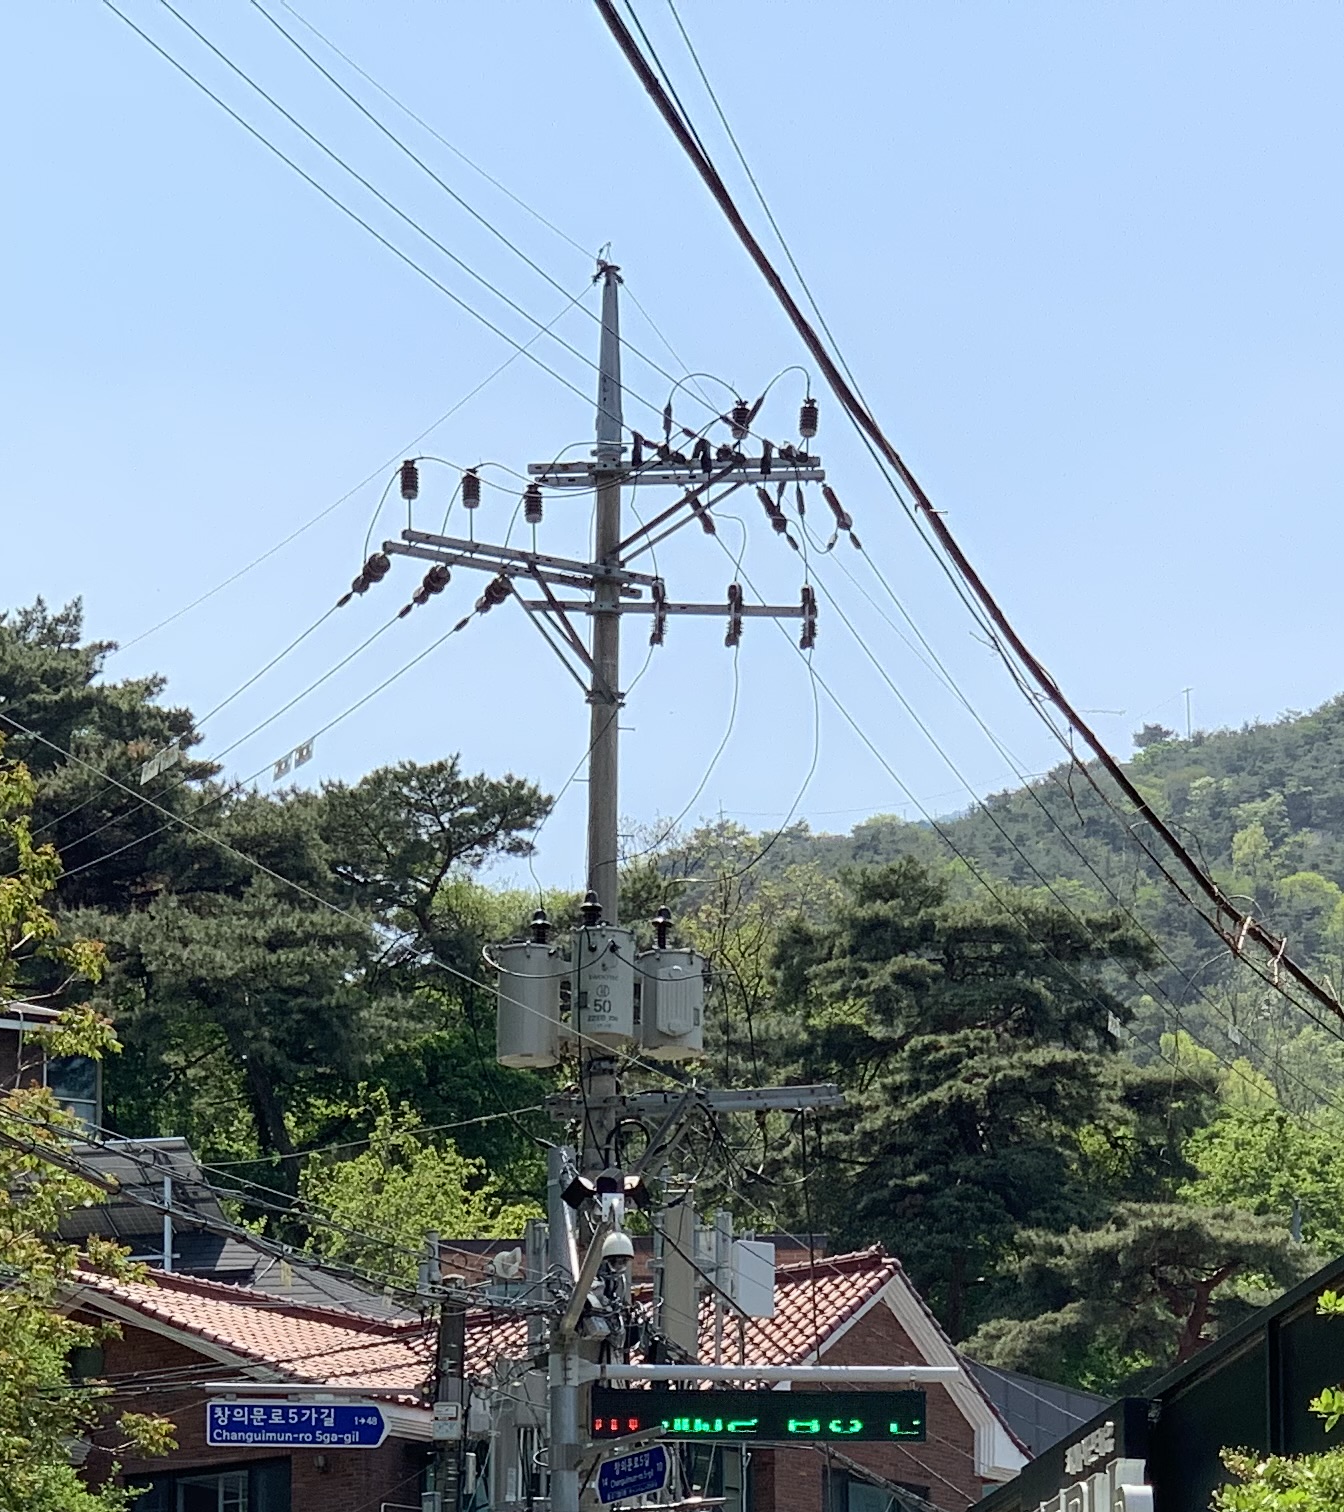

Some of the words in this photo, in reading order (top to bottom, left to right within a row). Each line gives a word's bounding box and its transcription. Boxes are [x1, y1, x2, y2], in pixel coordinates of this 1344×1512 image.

[593, 998, 612, 1014] 50
[213, 1406, 336, 1428] 창의문로5가길
[212, 1429, 313, 1445] Changuimun-ro
[315, 1430, 360, 1446] 5ga-gil
